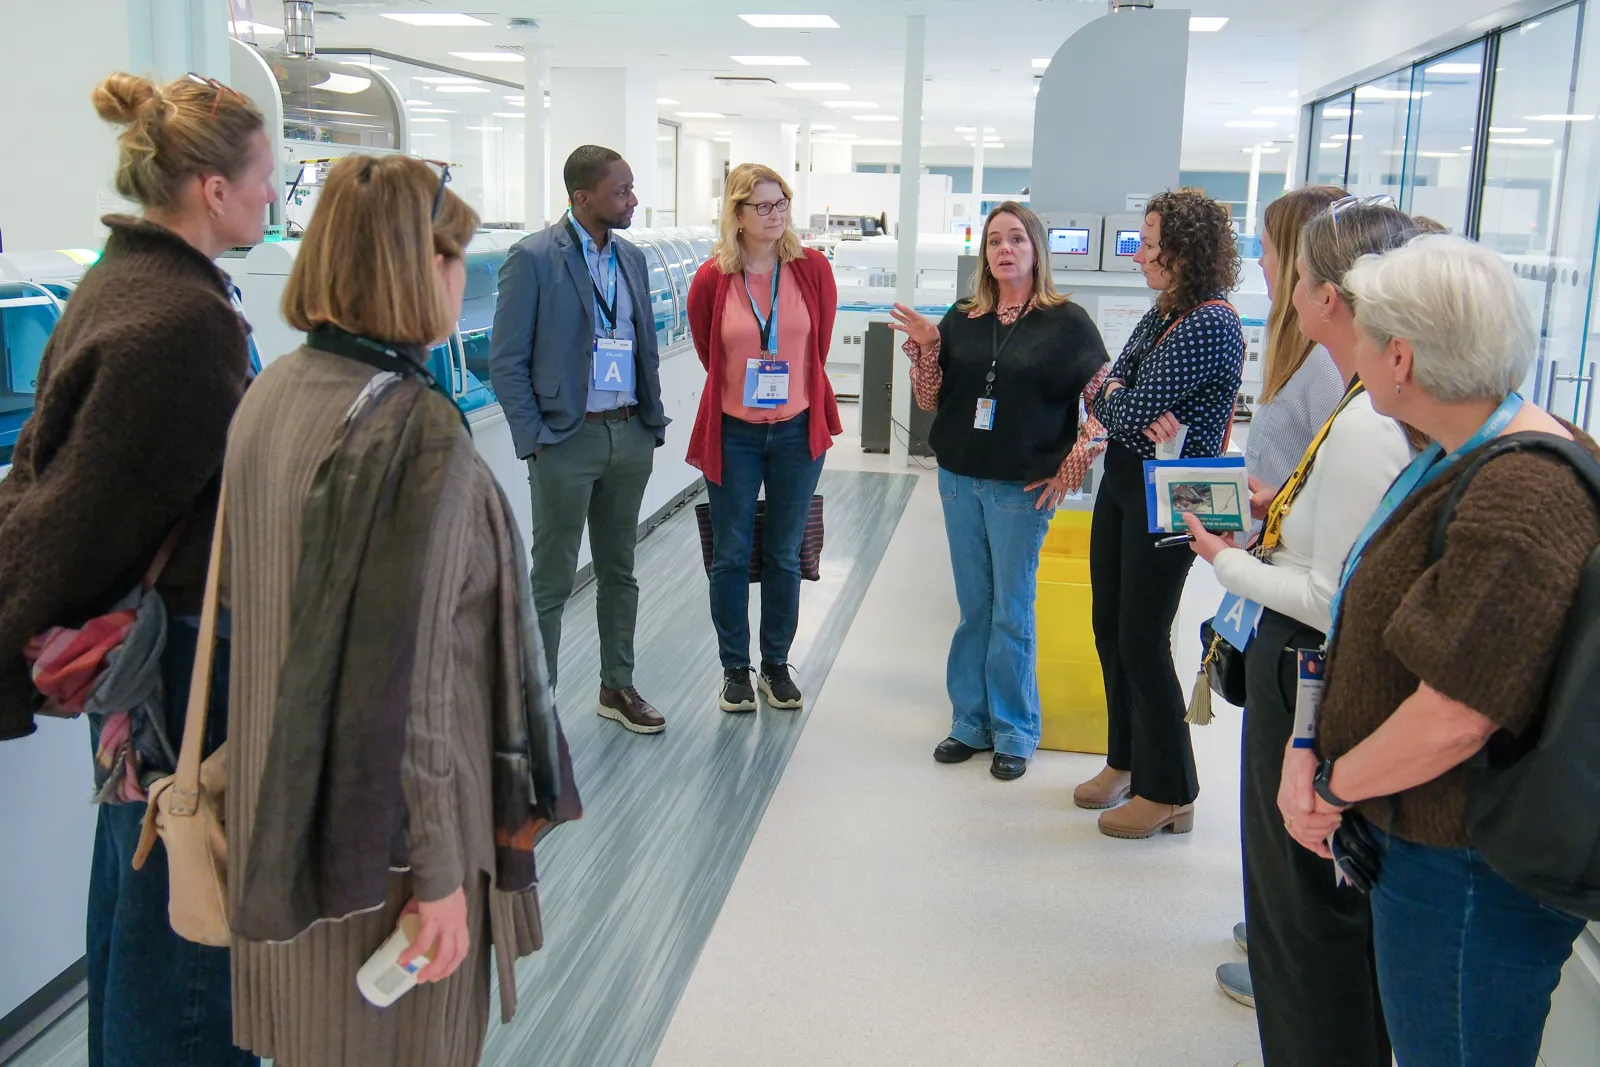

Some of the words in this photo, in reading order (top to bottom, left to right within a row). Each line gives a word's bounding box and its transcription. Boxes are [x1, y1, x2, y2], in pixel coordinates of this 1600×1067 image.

[604, 361, 622, 383] A
[1271, 495, 1286, 515] Author
[1223, 597, 1245, 632] A
